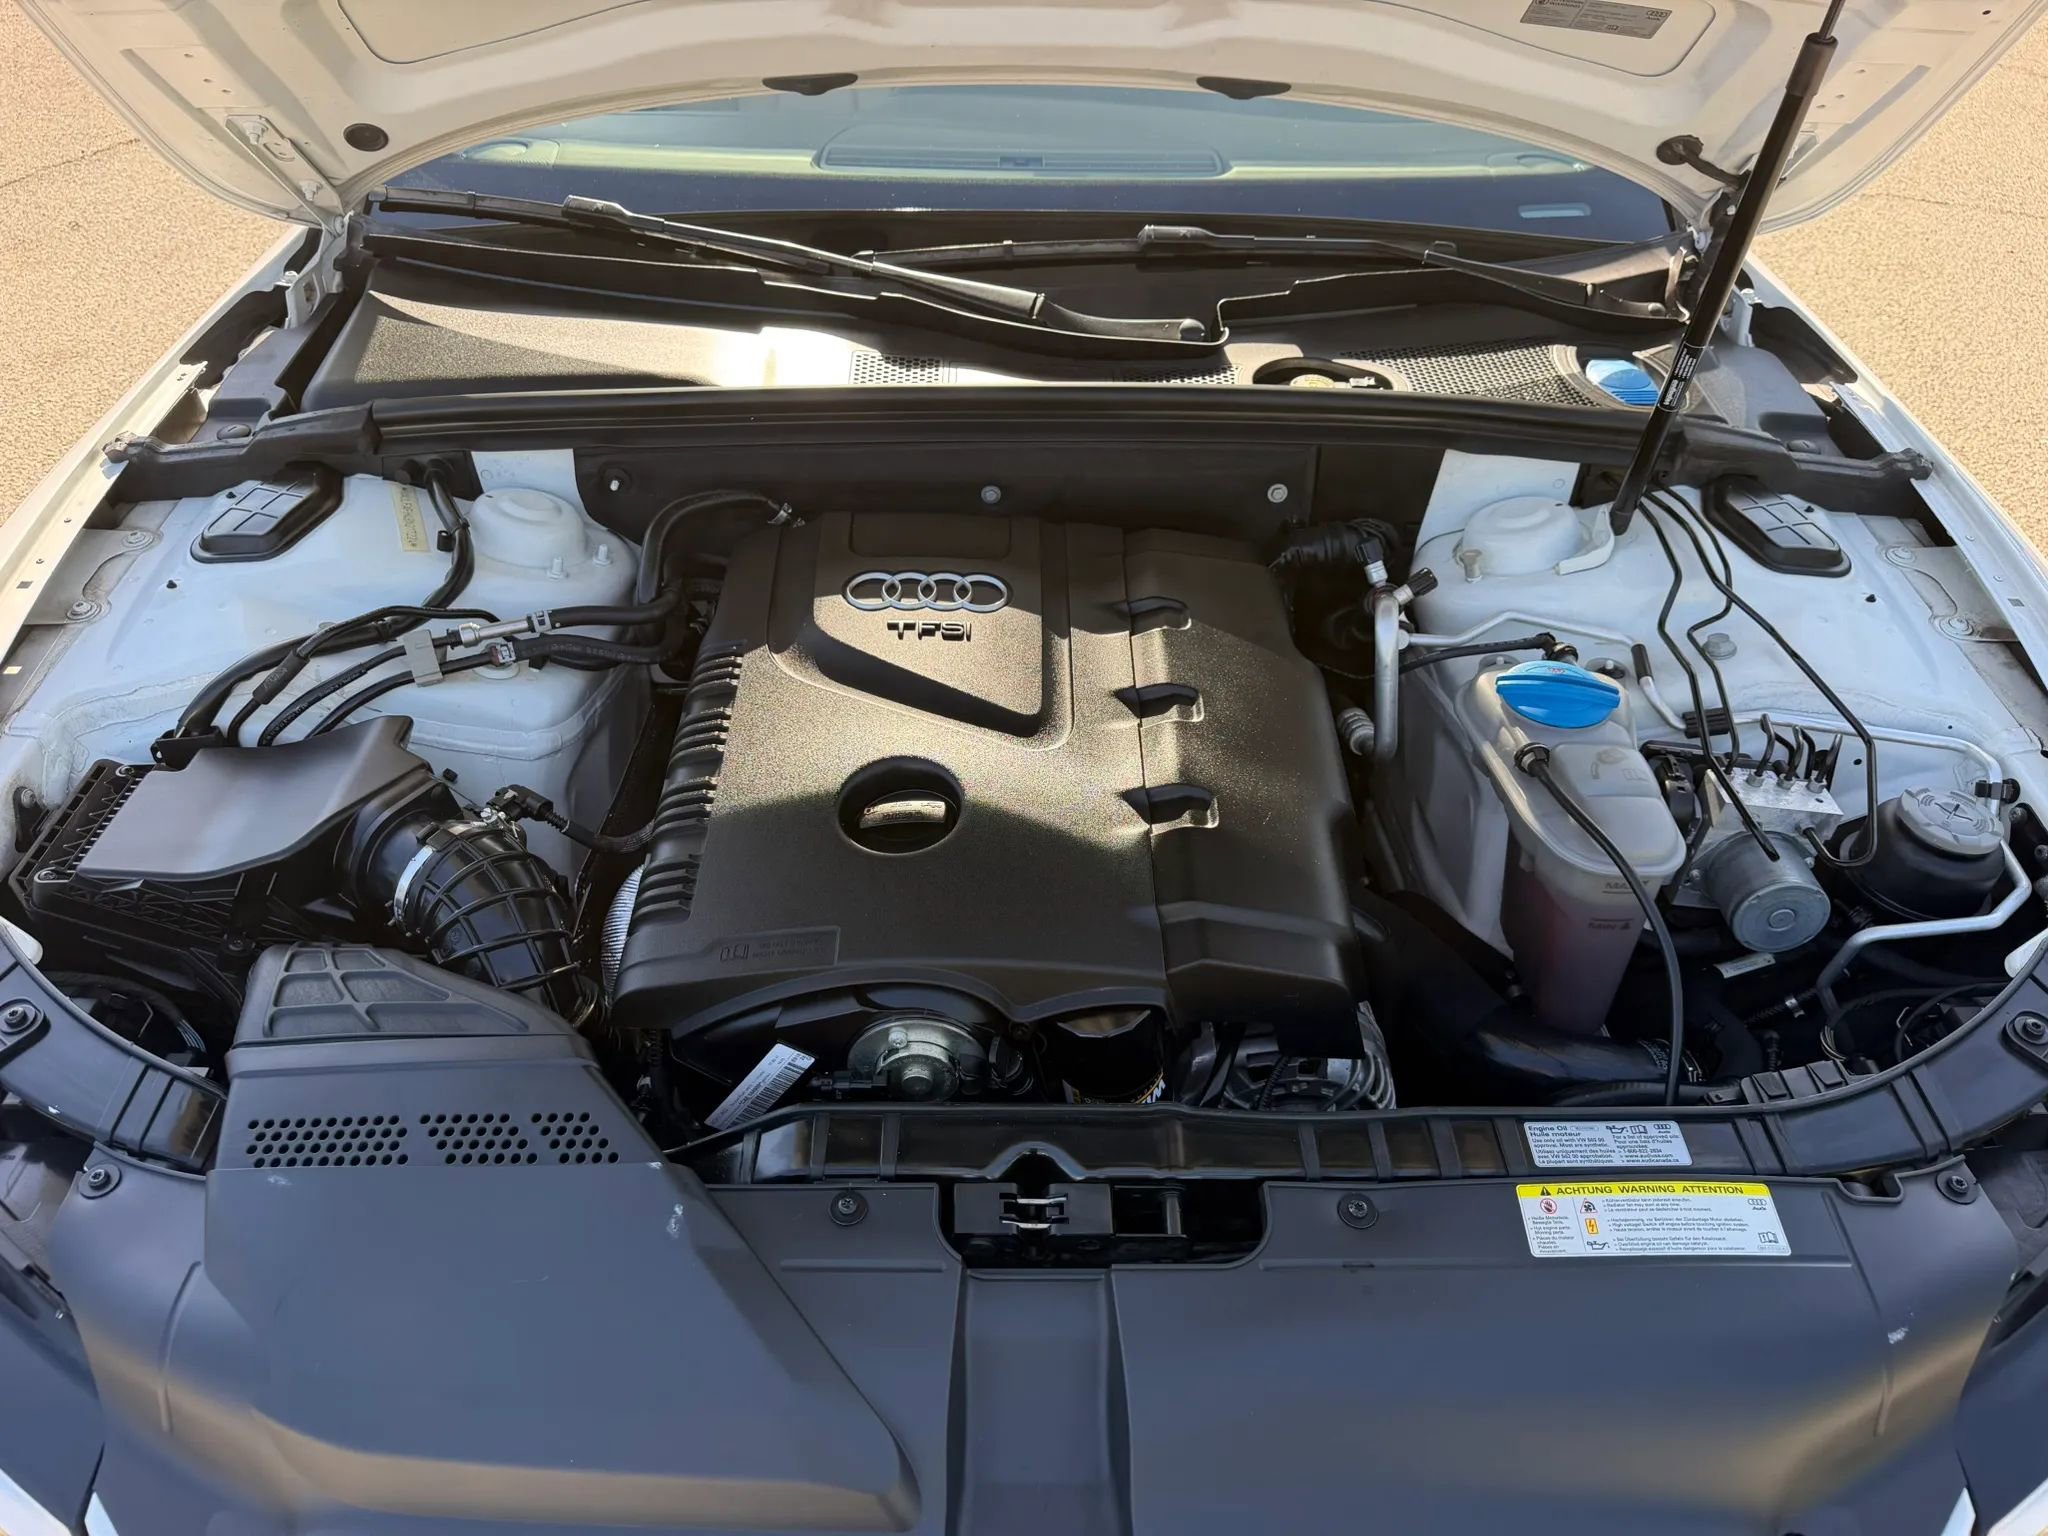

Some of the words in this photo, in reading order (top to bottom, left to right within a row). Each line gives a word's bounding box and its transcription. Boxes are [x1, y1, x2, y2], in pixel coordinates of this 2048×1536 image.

[887, 620, 971, 641] TFSI
[1557, 1186, 1612, 1195] ACHTUNG
[1618, 1185, 1675, 1194] WARNING
[1682, 1186, 1743, 1194] ATTENTION
